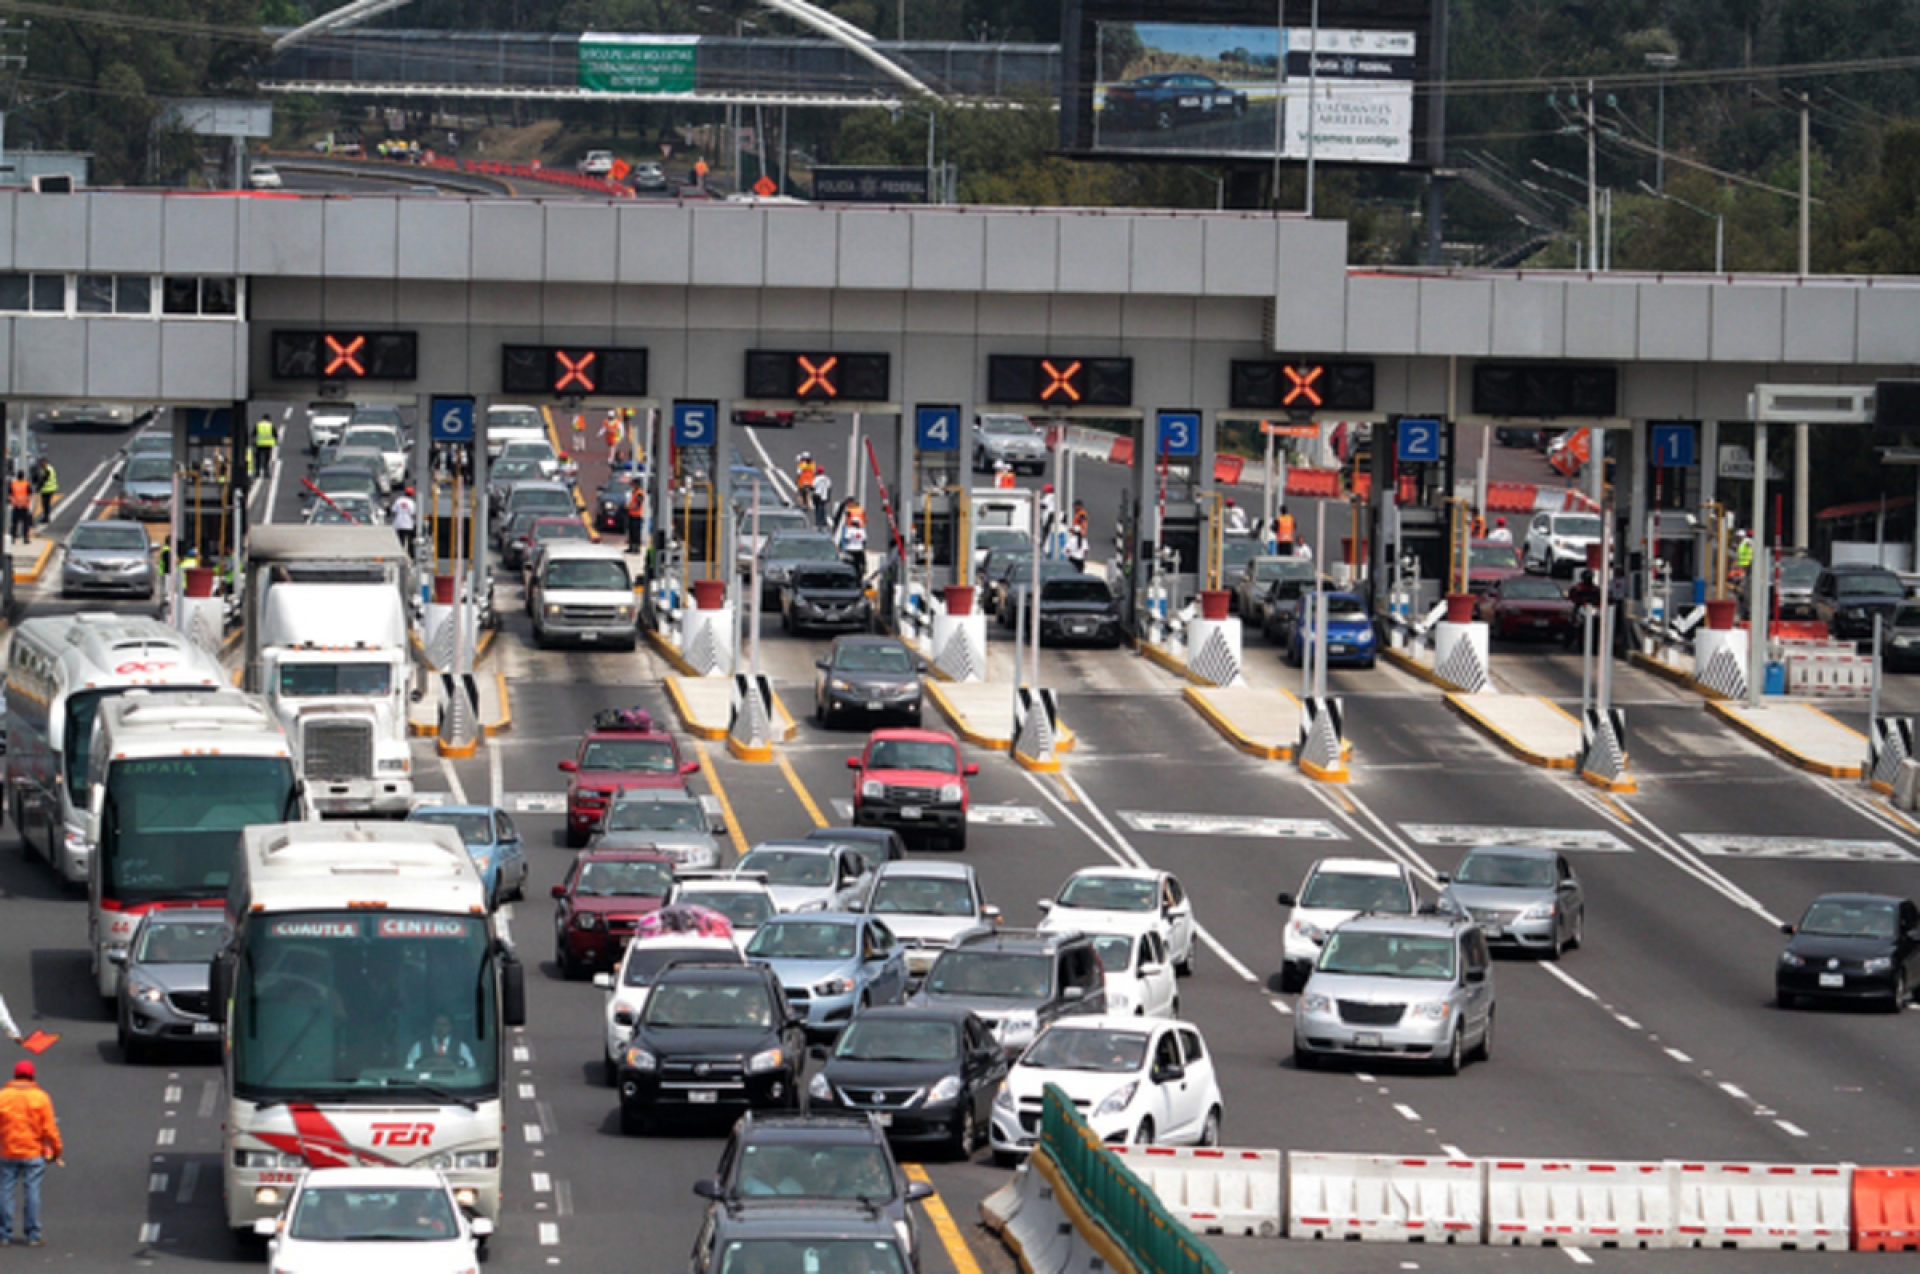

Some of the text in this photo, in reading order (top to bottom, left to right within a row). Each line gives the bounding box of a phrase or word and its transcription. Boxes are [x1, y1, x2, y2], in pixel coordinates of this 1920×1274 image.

[442, 407, 463, 433] 6
[683, 411, 704, 438] 5
[926, 415, 948, 442] 4
[1168, 421, 1189, 448] 3
[1408, 427, 1430, 453] 2
[1667, 433, 1679, 460] 1
[276, 921, 354, 937] CUAUTLA
[383, 918, 461, 934] CENTRO
[370, 1122, 435, 1146] TER
